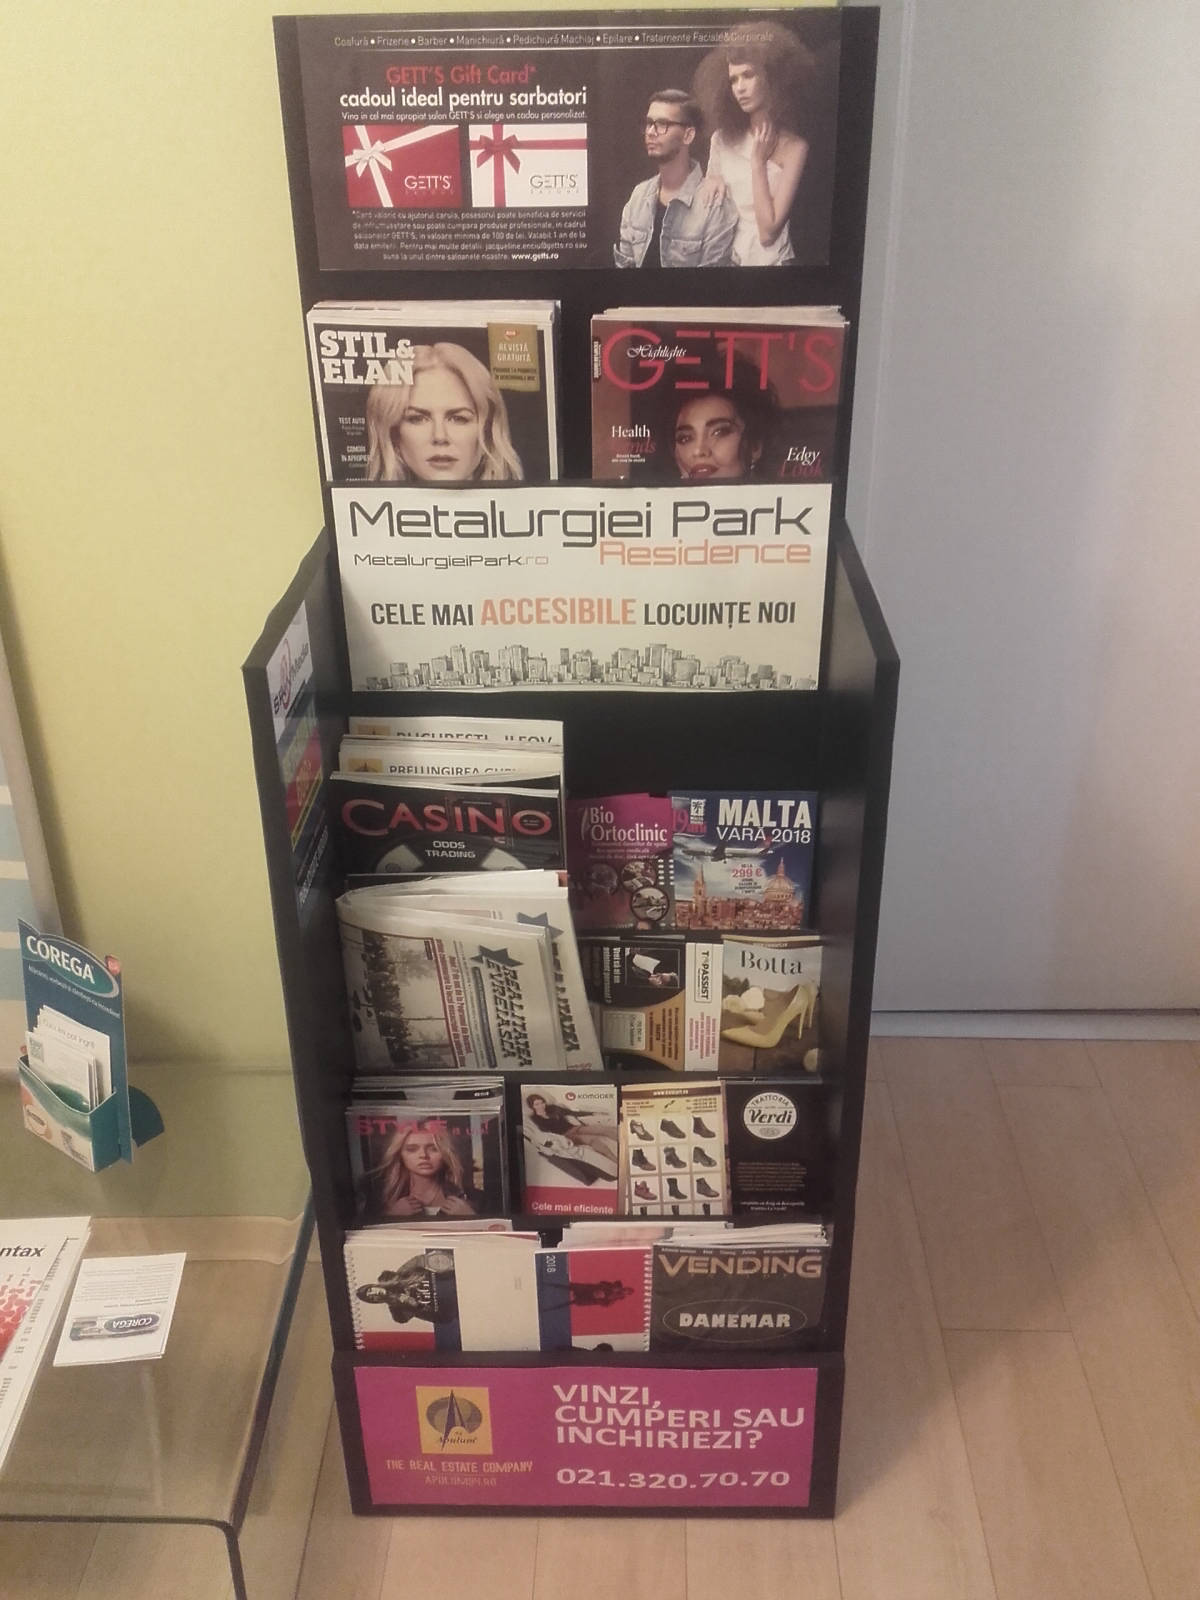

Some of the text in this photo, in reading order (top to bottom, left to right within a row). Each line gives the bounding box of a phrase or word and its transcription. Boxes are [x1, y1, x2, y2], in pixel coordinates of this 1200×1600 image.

[417, 35, 448, 46] Barber
[386, 65, 445, 85] GETT'S
[450, 64, 481, 84] Gift
[339, 85, 587, 111] cadoul ideal pentru sarbatori
[381, 111, 395, 120] mai
[396, 111, 427, 122] apropiat
[428, 111, 447, 120] salon
[506, 111, 515, 119] un
[517, 109, 540, 119] cadou
[404, 175, 452, 190] GETT'S
[529, 174, 579, 189] GETT'S
[602, 328, 836, 392] GETT'S
[626, 344, 687, 362] Highlights
[321, 358, 416, 386] ELAN
[611, 424, 651, 438] Health
[786, 446, 821, 466] Edgy
[349, 496, 814, 548] Metalurgiei Park
[353, 552, 549, 570] MetalurgieiPark.ro
[599, 538, 812, 567] Residence
[370, 602, 425, 626] CELE
[432, 603, 474, 626] MAI
[480, 597, 637, 626] ACCESIBILE
[757, 600, 796, 624] NOI
[341, 798, 553, 837] CASINO
[590, 805, 614, 824] Bio
[718, 799, 812, 829] MALTA
[591, 822, 668, 842] Ortoclinic
[771, 828, 812, 845] 2018
[425, 849, 477, 859] TRADING
[432, 840, 466, 849] ODDS
[26, 935, 96, 985] COREGA
[749, 1109, 793, 1124] Verdi
[531, 1201, 614, 1215] Cele mai eficiente
[658, 1254, 823, 1279] VENDING
[112, 1316, 153, 1330] COREGA
[679, 1312, 792, 1328] DANEMAR
[552, 1384, 662, 1409] VINZI,
[555, 1405, 806, 1429] CUMPERI SAU
[556, 1425, 763, 1450] INCHIRIEZI?
[385, 1459, 534, 1473] THE REAL ESTATE COMPANY
[555, 1468, 792, 1489] 021.320.70.70
